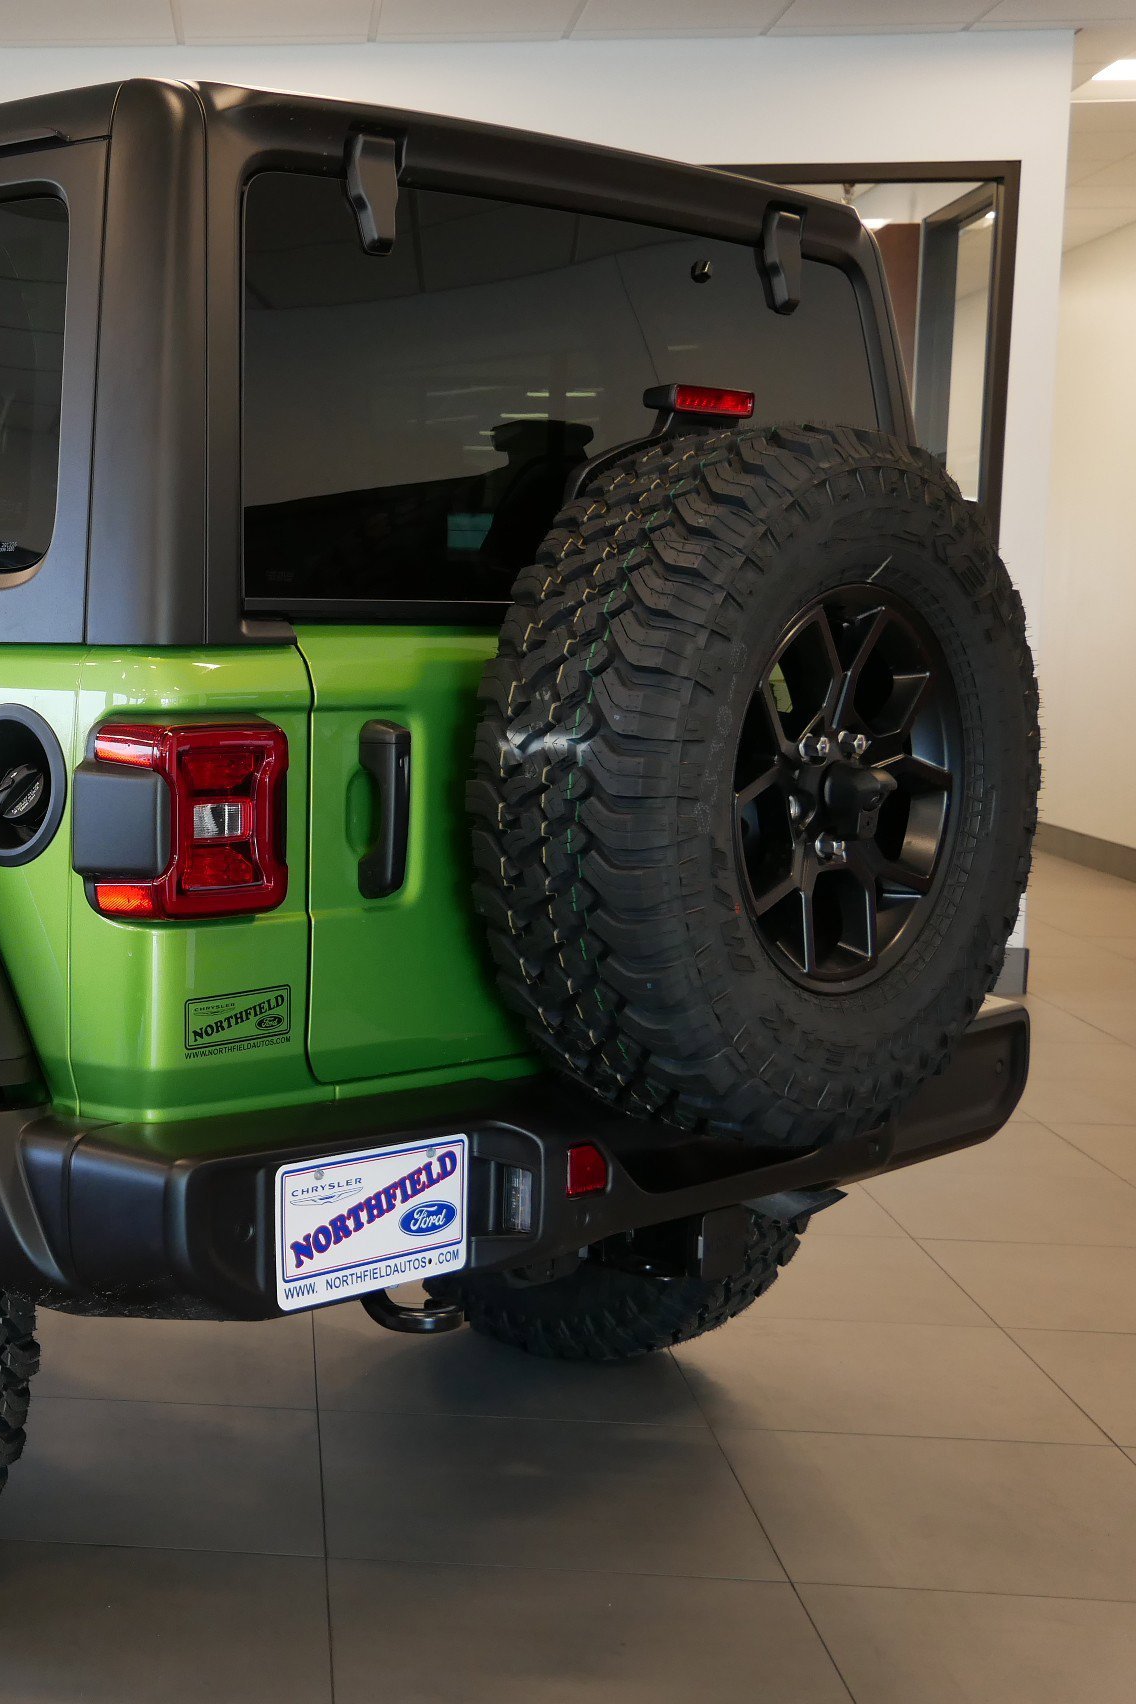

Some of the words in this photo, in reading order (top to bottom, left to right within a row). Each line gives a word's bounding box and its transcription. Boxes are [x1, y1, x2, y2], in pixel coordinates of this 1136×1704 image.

[192, 994, 285, 1043] NORTHFIELD
[194, 1002, 236, 1012] CHRYSLER
[184, 1036, 292, 1060] WWW.NORTHFIELDAUTOS.COM
[291, 1177, 363, 1198] CHRYSLER
[289, 1150, 458, 1269] NORTHFIELD
[410, 1205, 447, 1231] Ford
